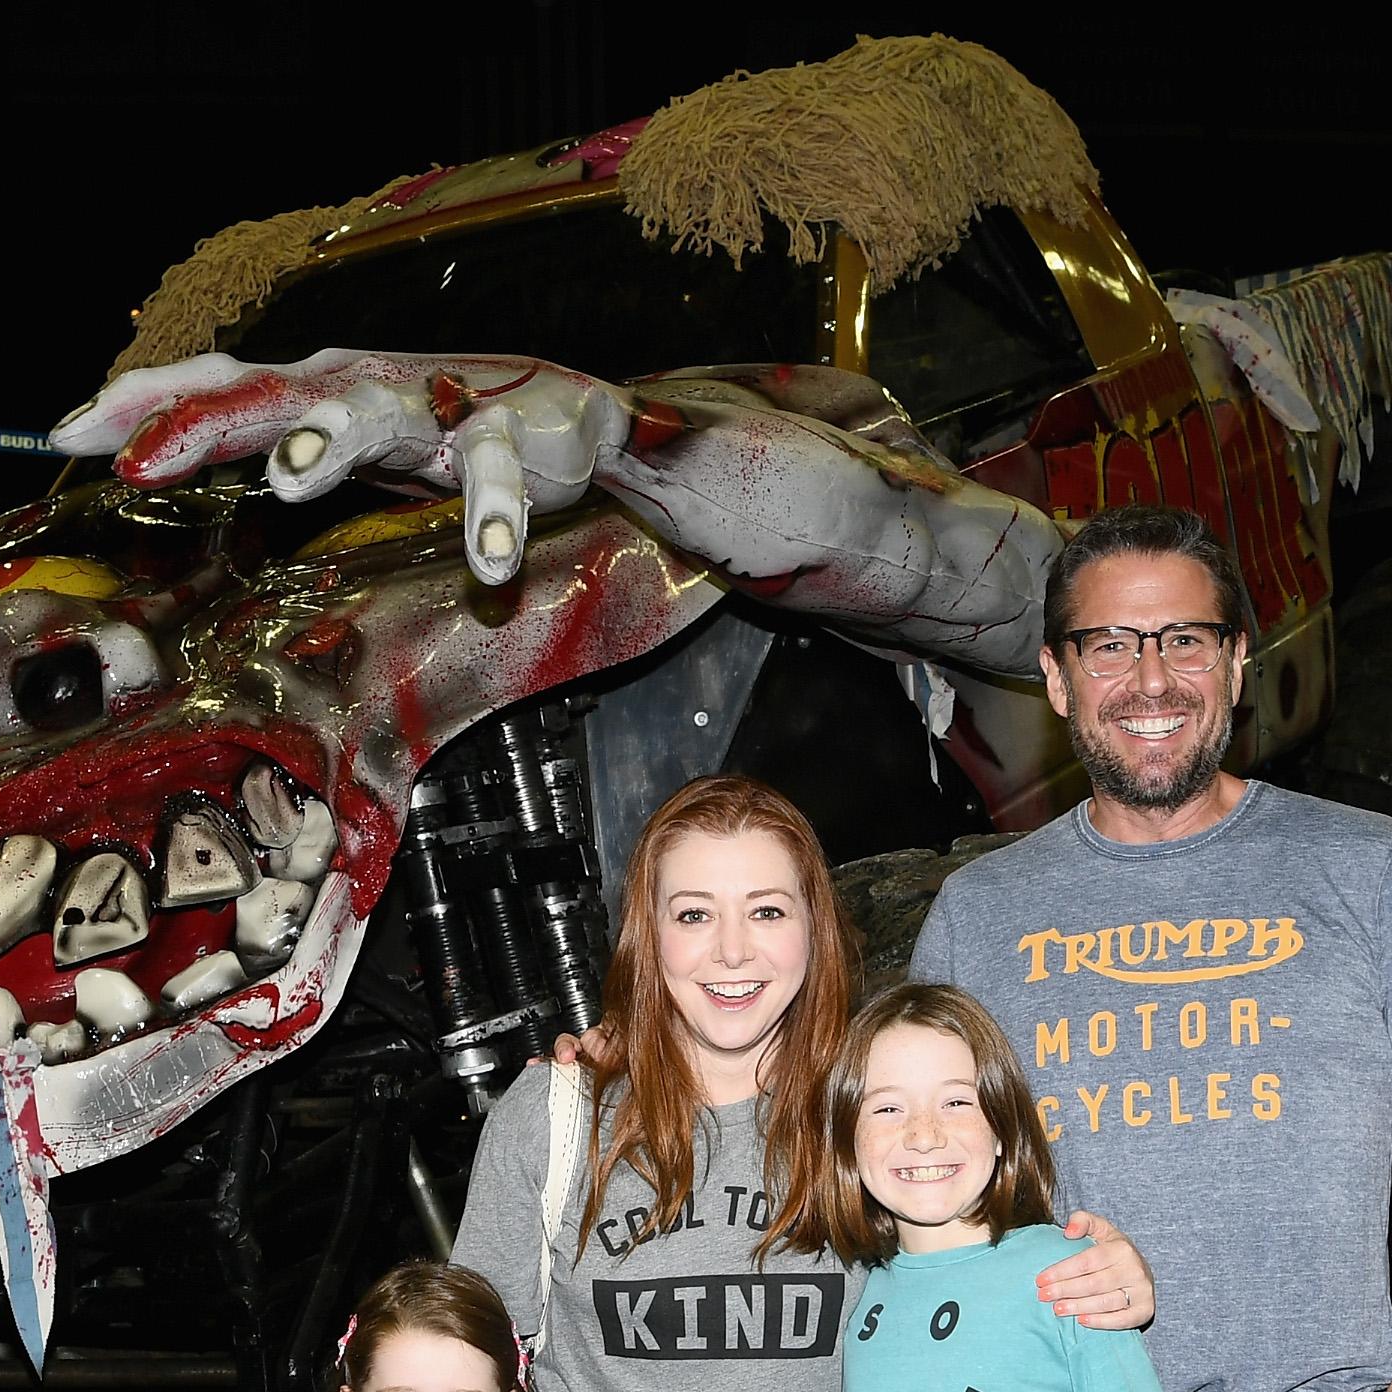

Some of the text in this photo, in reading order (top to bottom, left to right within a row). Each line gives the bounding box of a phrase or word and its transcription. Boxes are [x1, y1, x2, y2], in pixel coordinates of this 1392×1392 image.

[0, 434, 35, 450] BUD
[1017, 918, 1304, 984] TRIUMPH
[1036, 999, 1291, 1068] MOTOR-
[1037, 1073, 1282, 1143] CYCLES
[596, 1191, 704, 1257] COL
[616, 1284, 822, 1350] KIND
